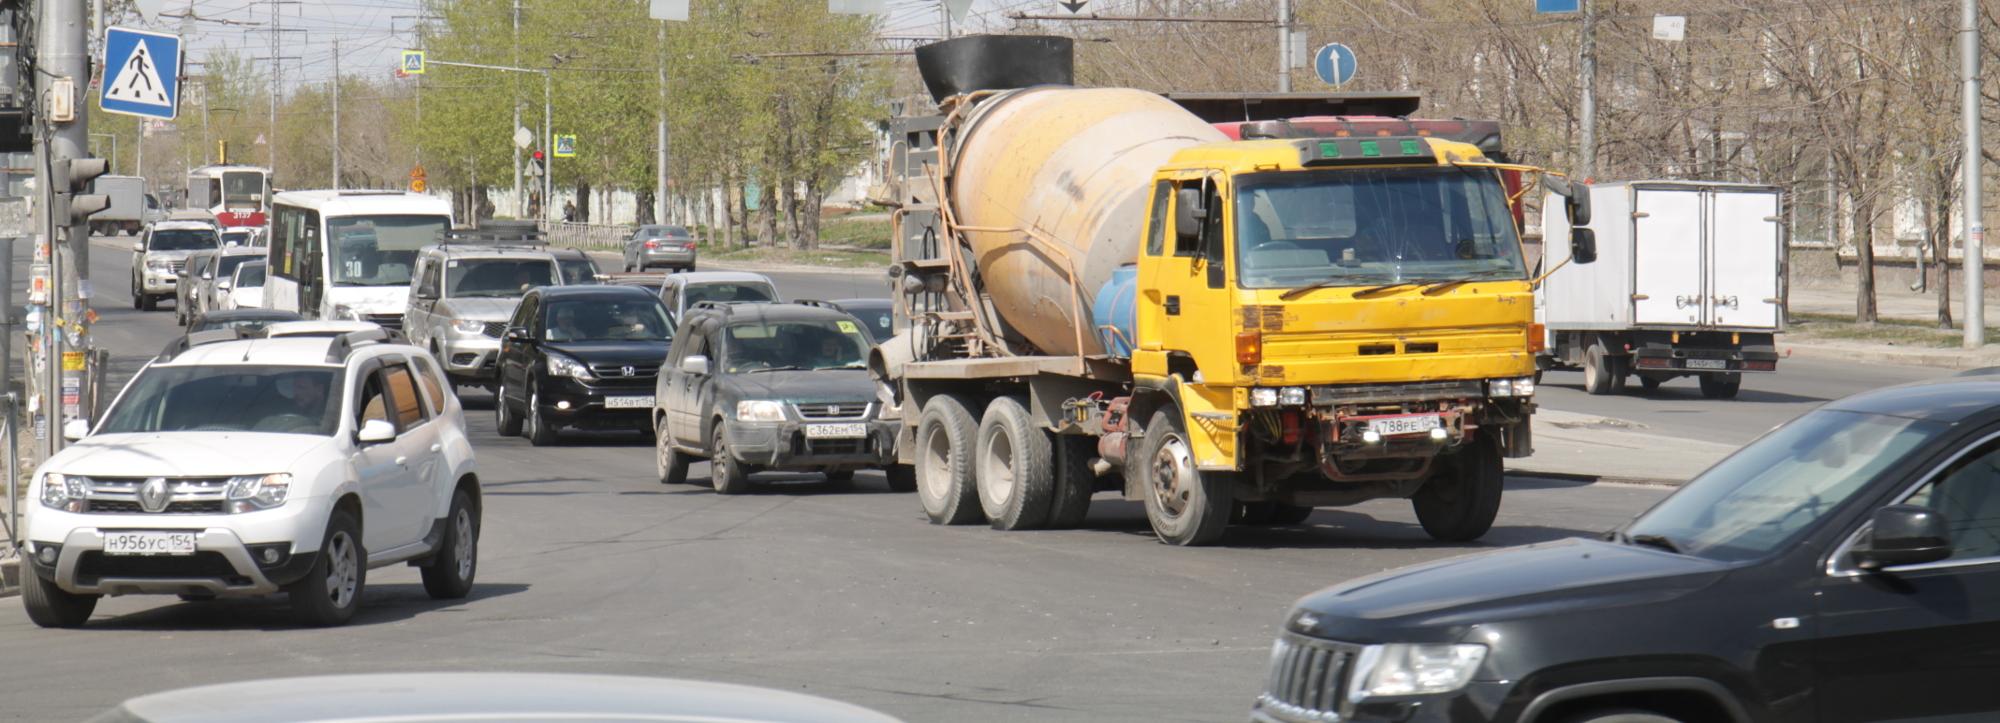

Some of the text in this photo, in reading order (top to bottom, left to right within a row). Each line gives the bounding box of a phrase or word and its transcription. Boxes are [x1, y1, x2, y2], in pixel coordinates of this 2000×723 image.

[346, 260, 362, 278] 30
[109, 535, 191, 550] Н956УС 154
